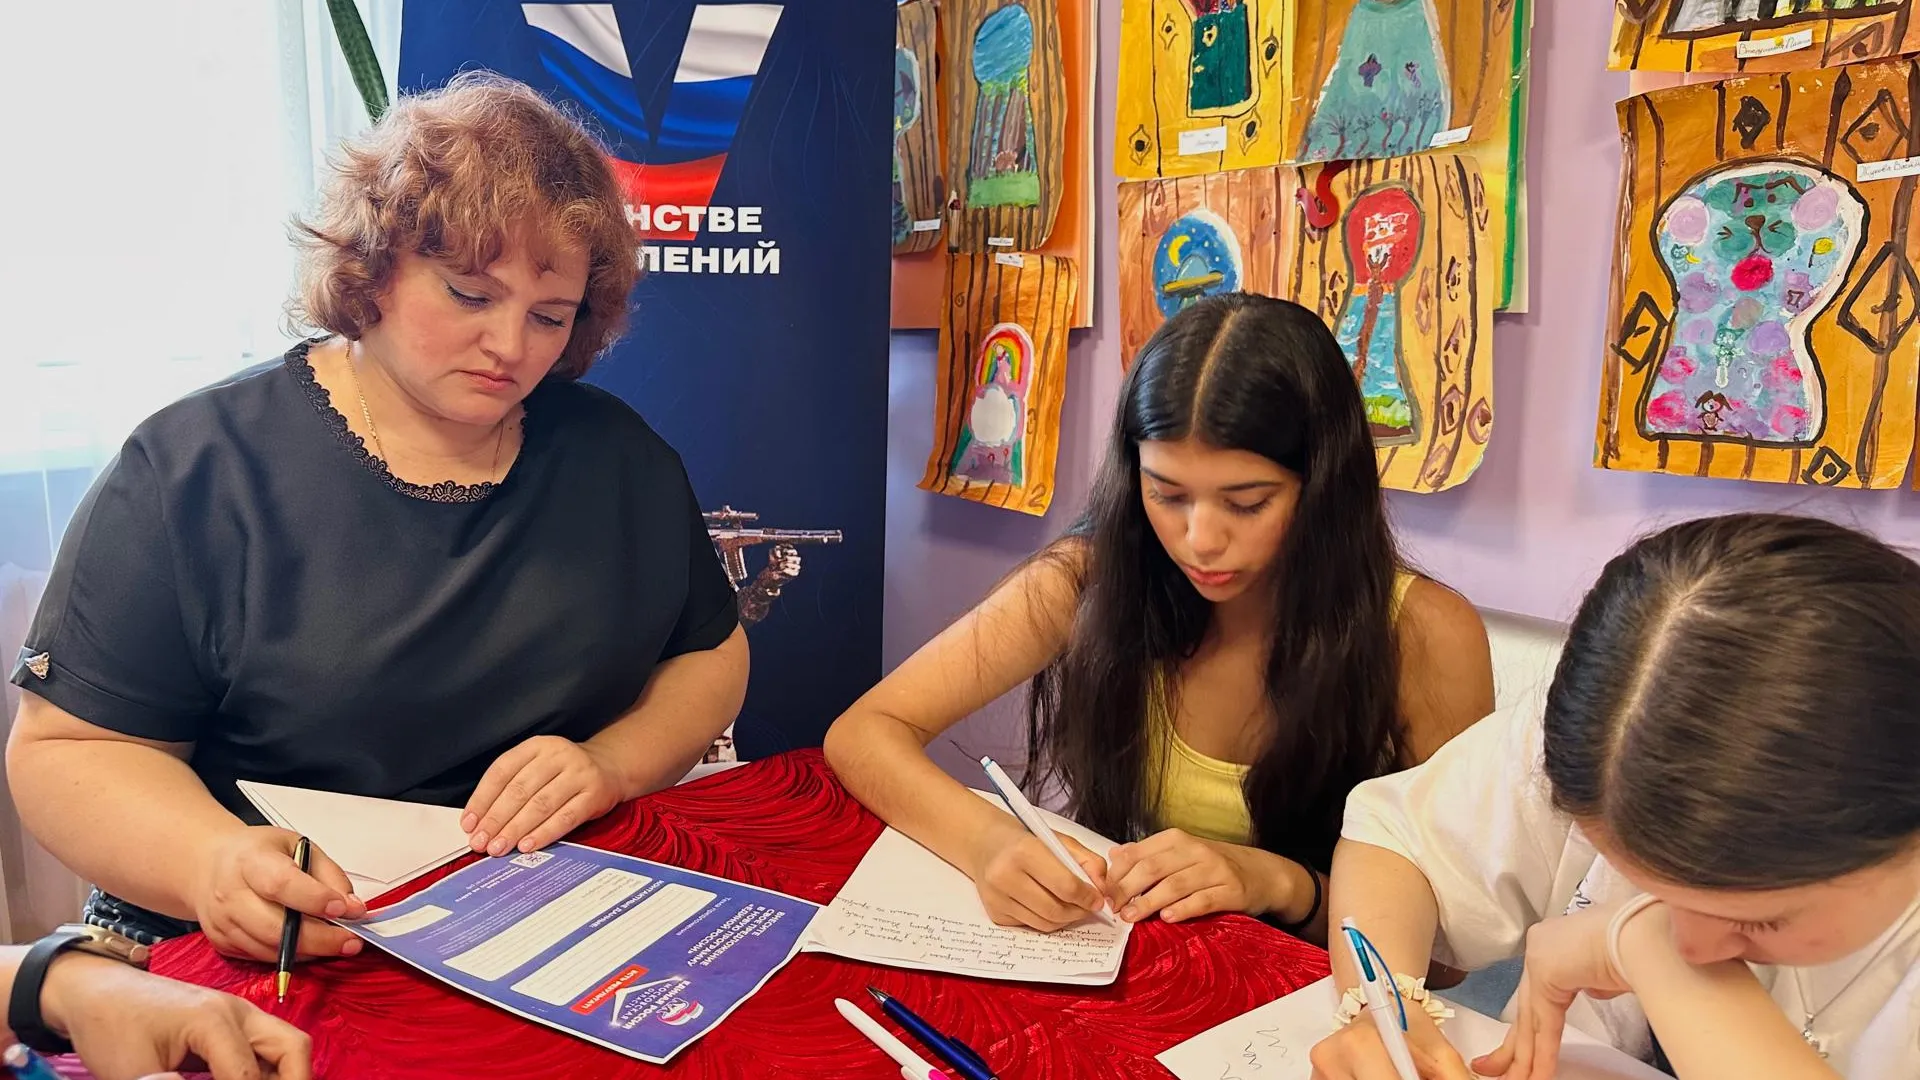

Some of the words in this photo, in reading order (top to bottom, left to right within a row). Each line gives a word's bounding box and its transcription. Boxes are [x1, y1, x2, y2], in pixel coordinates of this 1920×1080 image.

[624, 204, 762, 233] НСТВЕ
[637, 240, 780, 275] ЛЕНИЙ
[620, 879, 664, 911] КОНТАКТНЫЕ
[714, 896, 732, 909] Тема
[589, 905, 622, 929] ДАННЫЕ:
[676, 907, 716, 936] предложения
[721, 903, 754, 930] «ЕДИНОЙ
[731, 909, 760, 931] НОВУЮ
[752, 911, 786, 937] ВНЕСИТЕ
[754, 908, 775, 925] СВОЕ
[687, 928, 724, 954] РОССИИ»
[687, 930, 734, 967] ПРОГРАММУ
[700, 923, 757, 967] ПРЕДЛОЖЕНИЕ
[620, 969, 639, 983] ЕСТЬ
[582, 980, 622, 1009] РЕЗУЛЬТАТ!
[621, 983, 673, 1020] МОСКОВСКАЯ
[625, 988, 655, 1009] ОБЛАСТЬ
[656, 979, 692, 1005] ЕДИНАЯ
[622, 1003, 657, 1030] РОССИЯ
